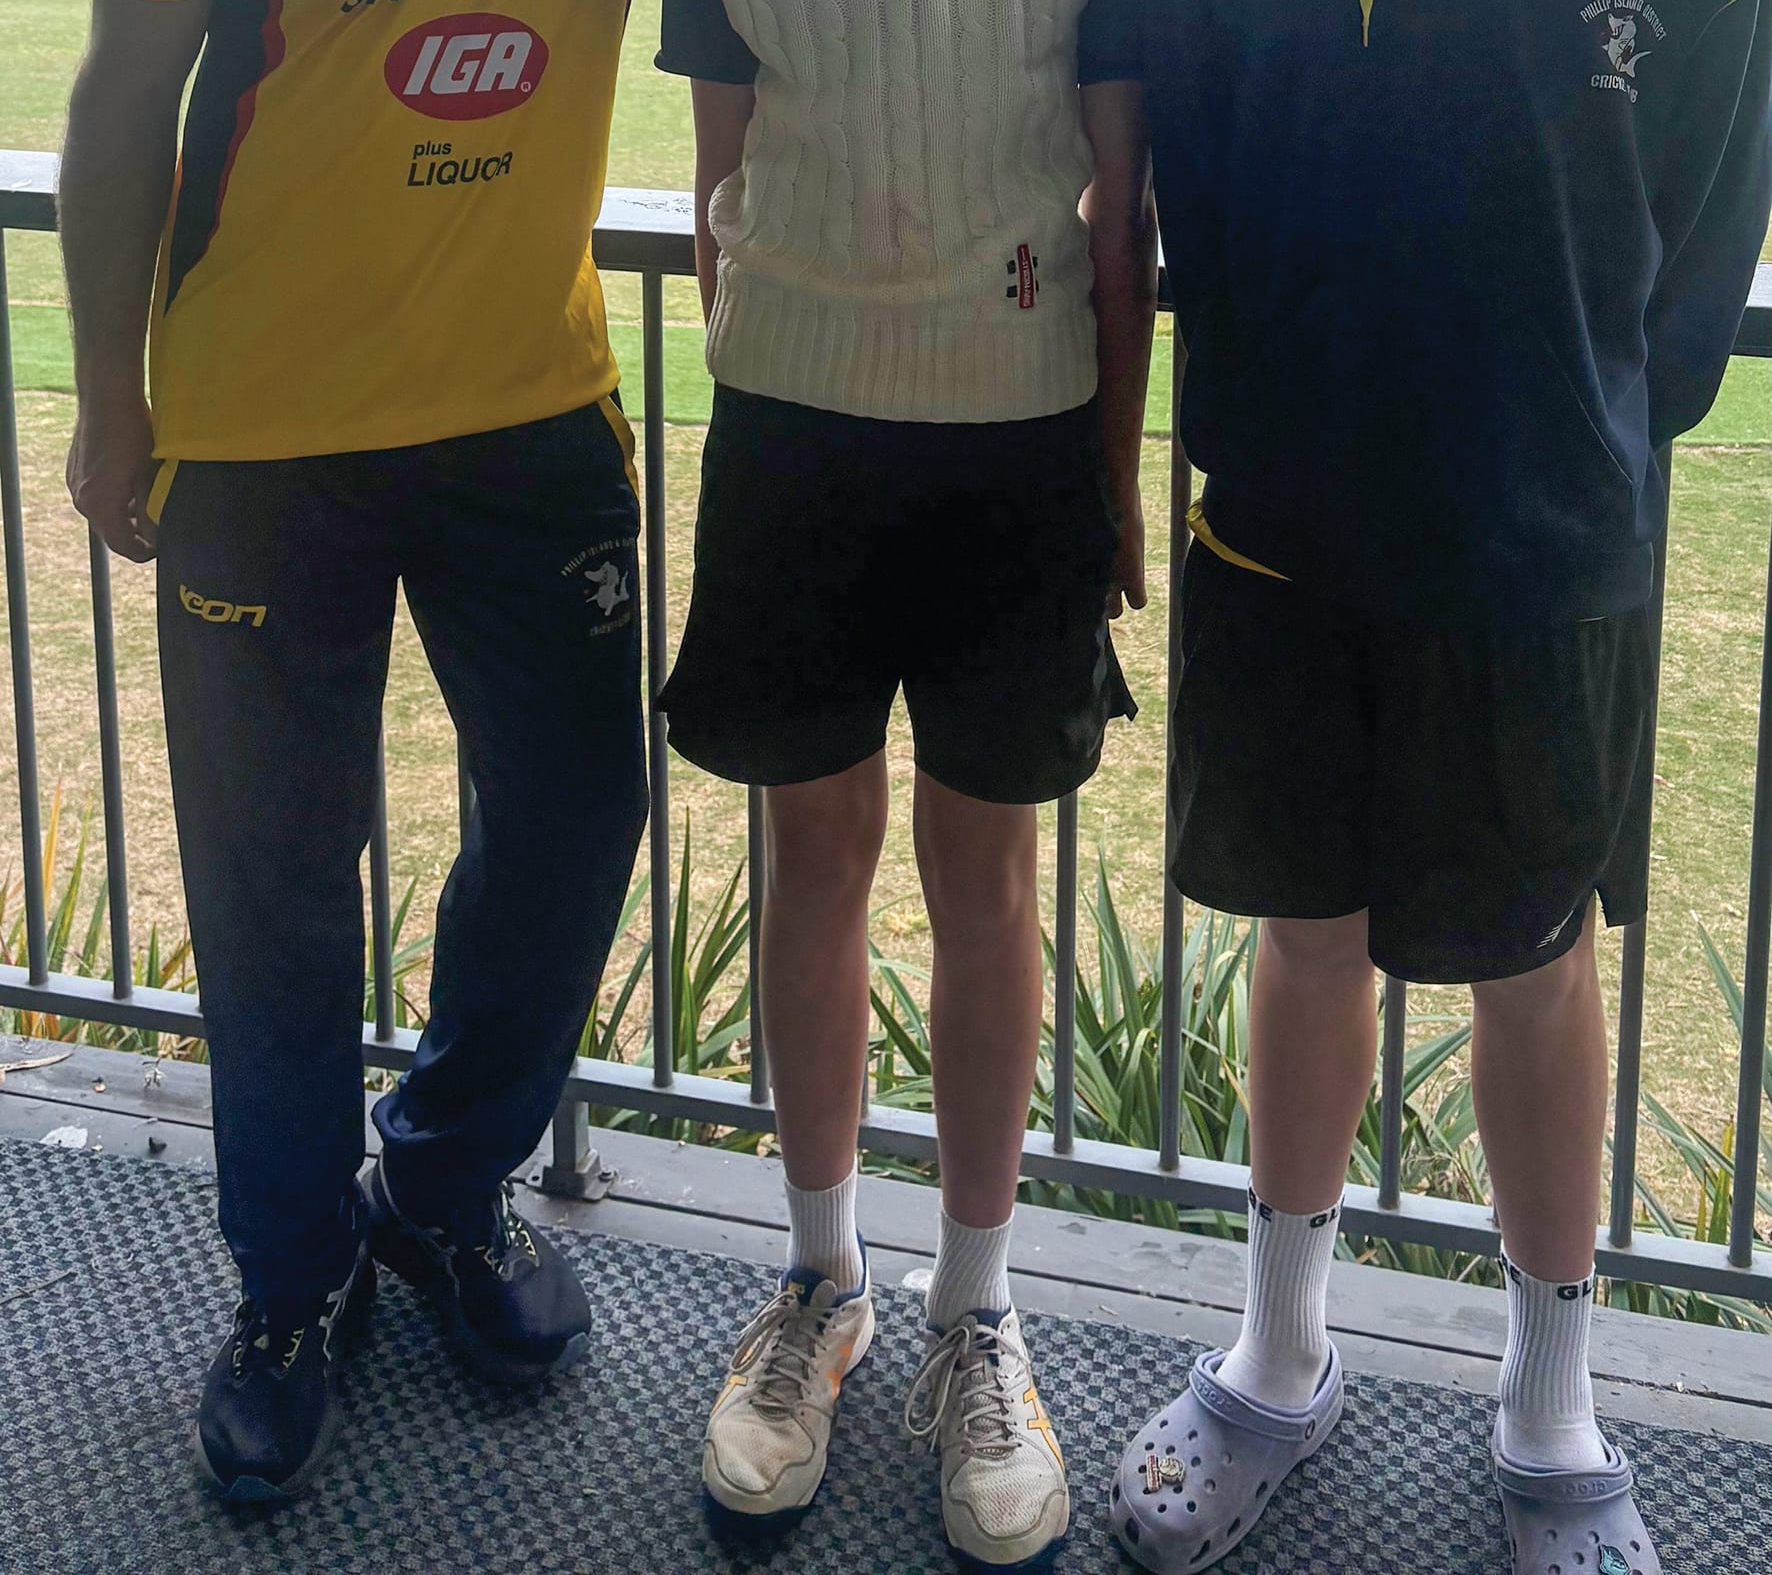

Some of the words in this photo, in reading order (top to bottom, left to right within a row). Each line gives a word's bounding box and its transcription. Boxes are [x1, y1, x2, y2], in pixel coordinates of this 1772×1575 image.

[1642, 4, 1668, 41] DISTRICT
[402, 31, 533, 97] IGA
[412, 141, 452, 160] plus
[407, 151, 514, 187] LIQUOR
